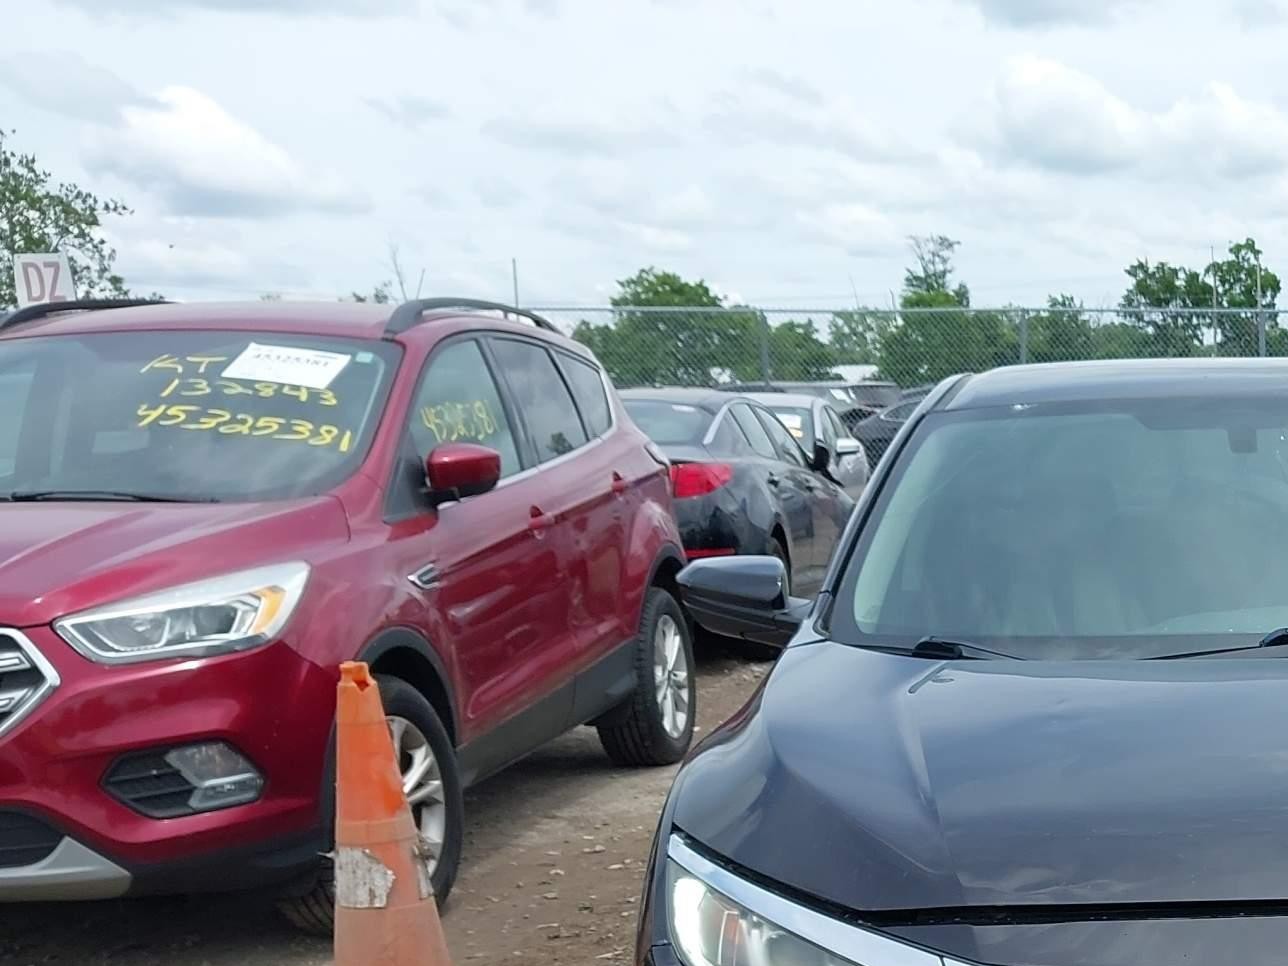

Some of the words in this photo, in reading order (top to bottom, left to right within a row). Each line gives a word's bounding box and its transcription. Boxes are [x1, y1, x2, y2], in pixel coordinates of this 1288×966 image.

[21, 261, 67, 302] DZ
[160, 378, 337, 406] 132843
[137, 404, 352, 452] 45325381
